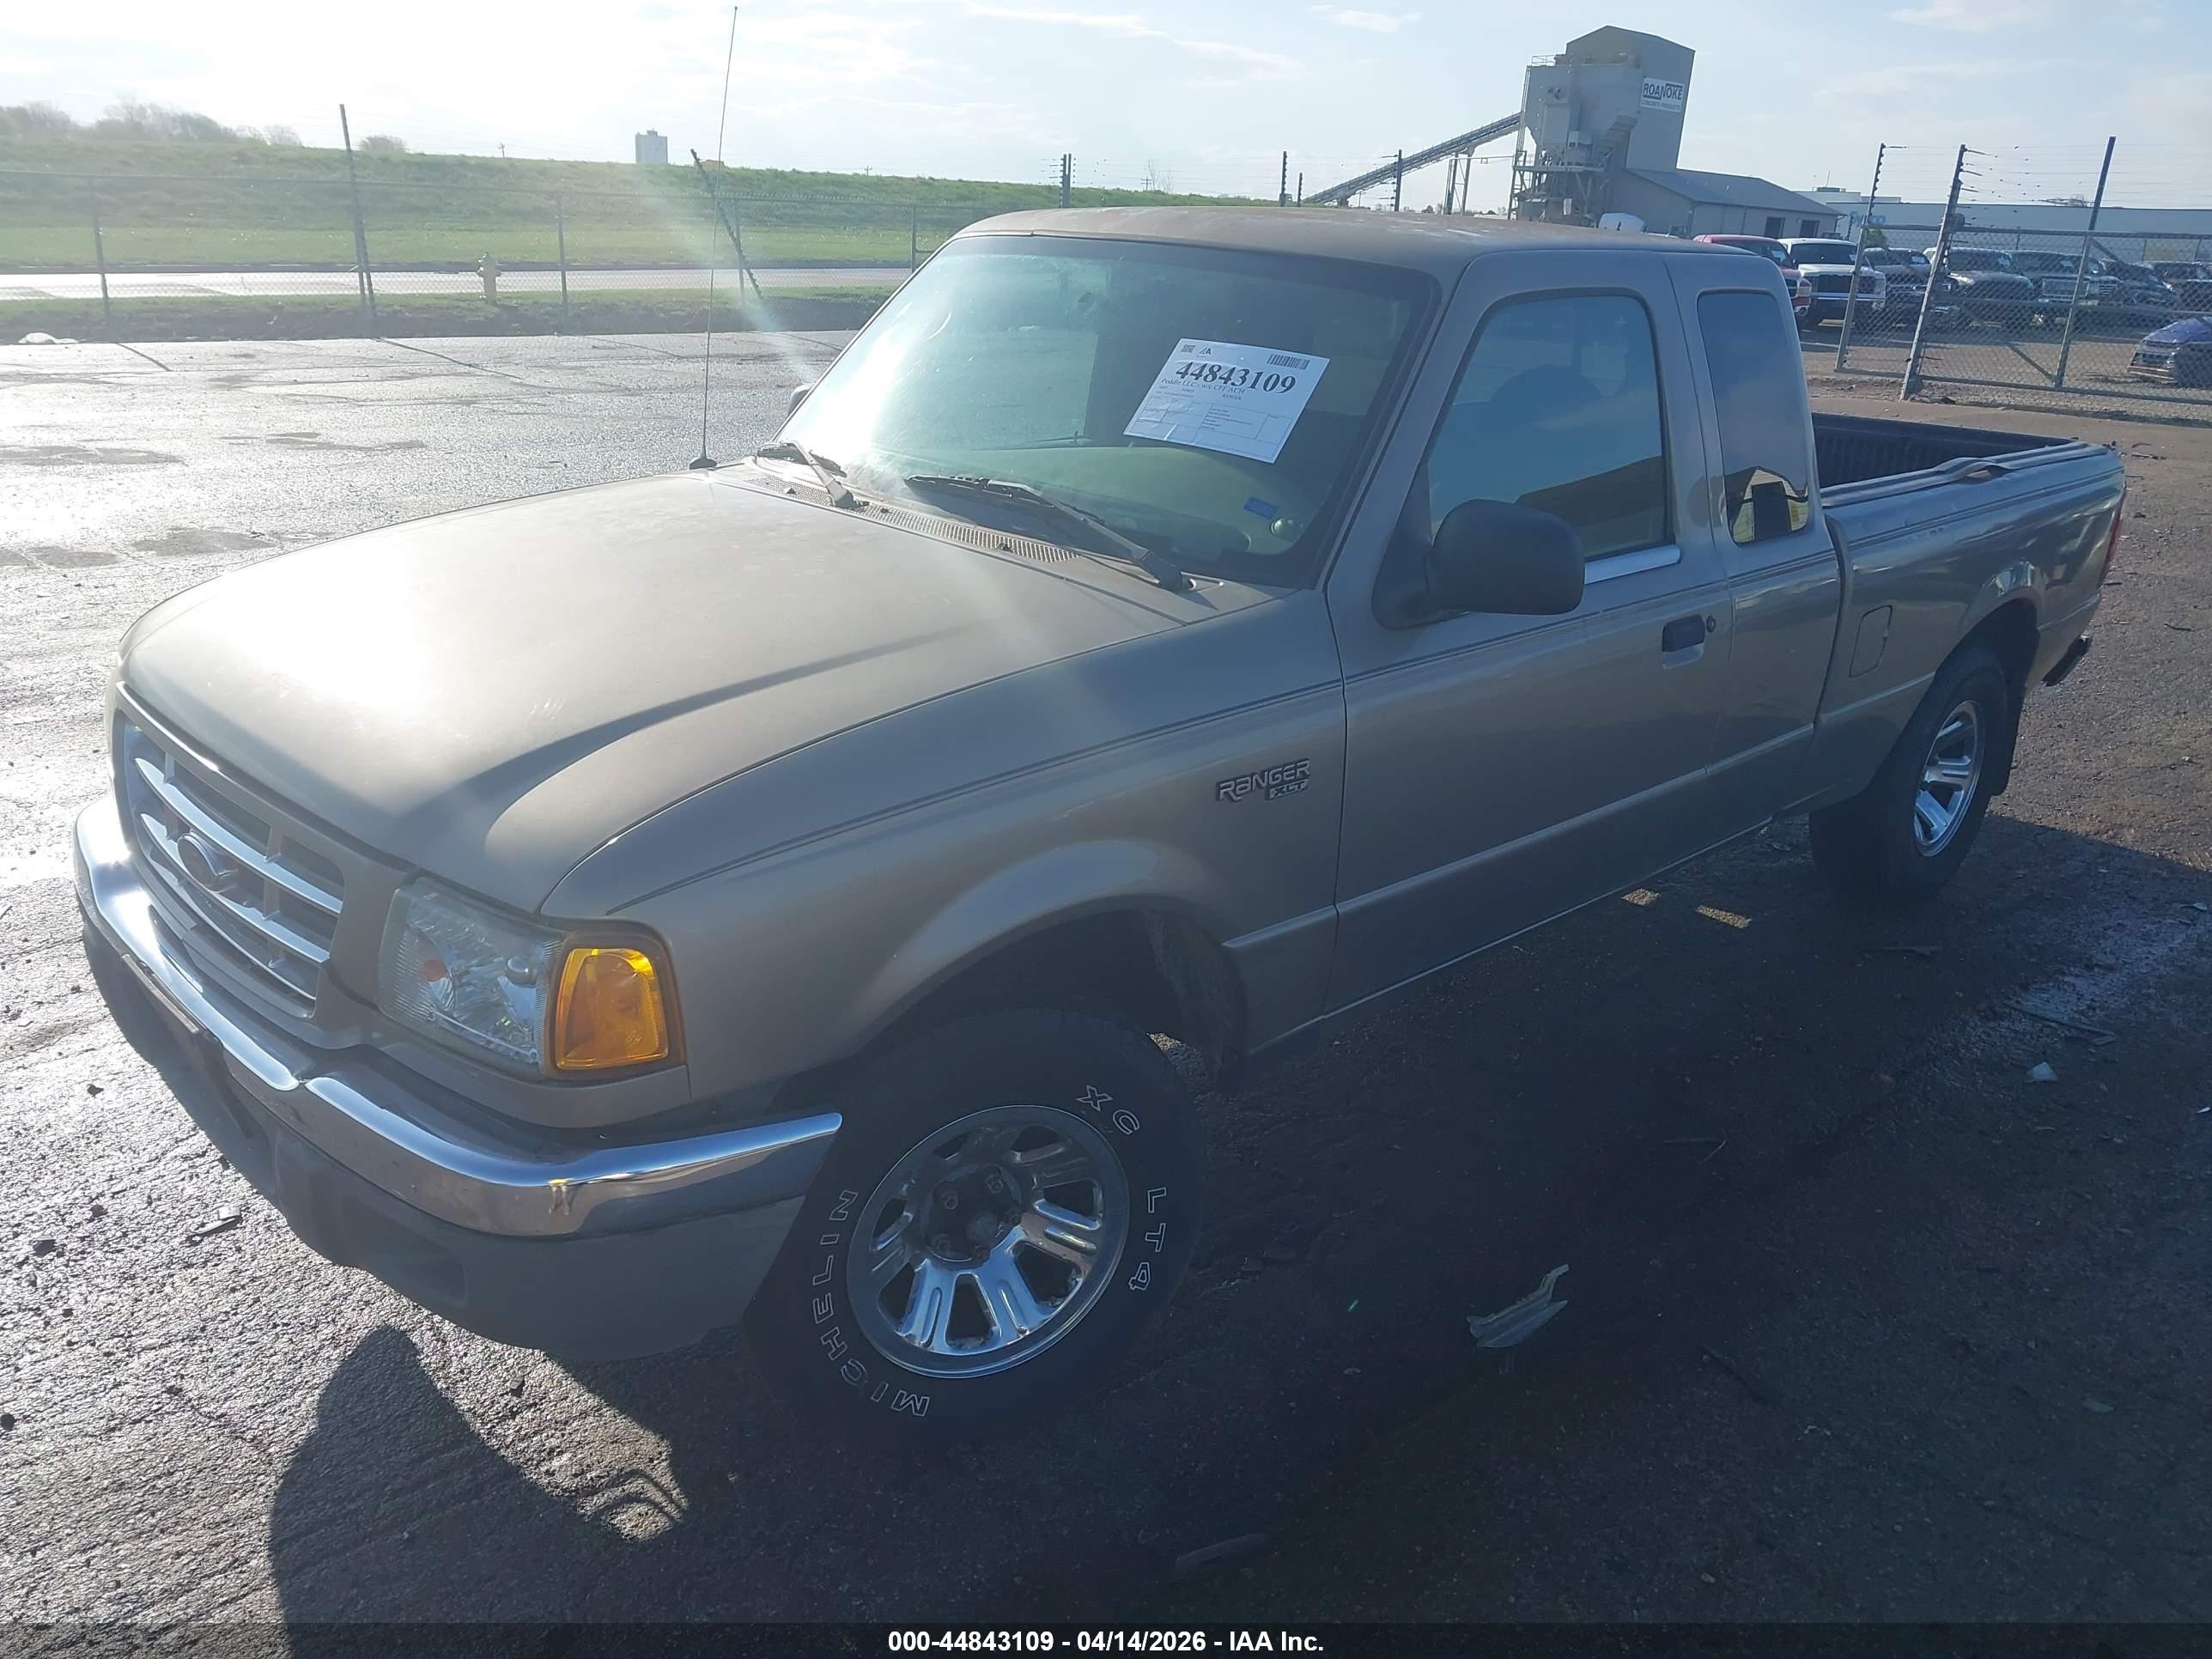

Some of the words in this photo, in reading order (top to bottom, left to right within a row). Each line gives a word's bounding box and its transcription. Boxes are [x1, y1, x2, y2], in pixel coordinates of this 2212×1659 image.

[1643, 82, 1683, 100] ROANOKE
[1175, 361, 1296, 394] 44843109
[1218, 759, 1310, 802] RANGER
[1269, 779, 1309, 799] XLT
[1075, 1085, 1140, 1135] XC
[812, 1188, 931, 1418] MICHELIN
